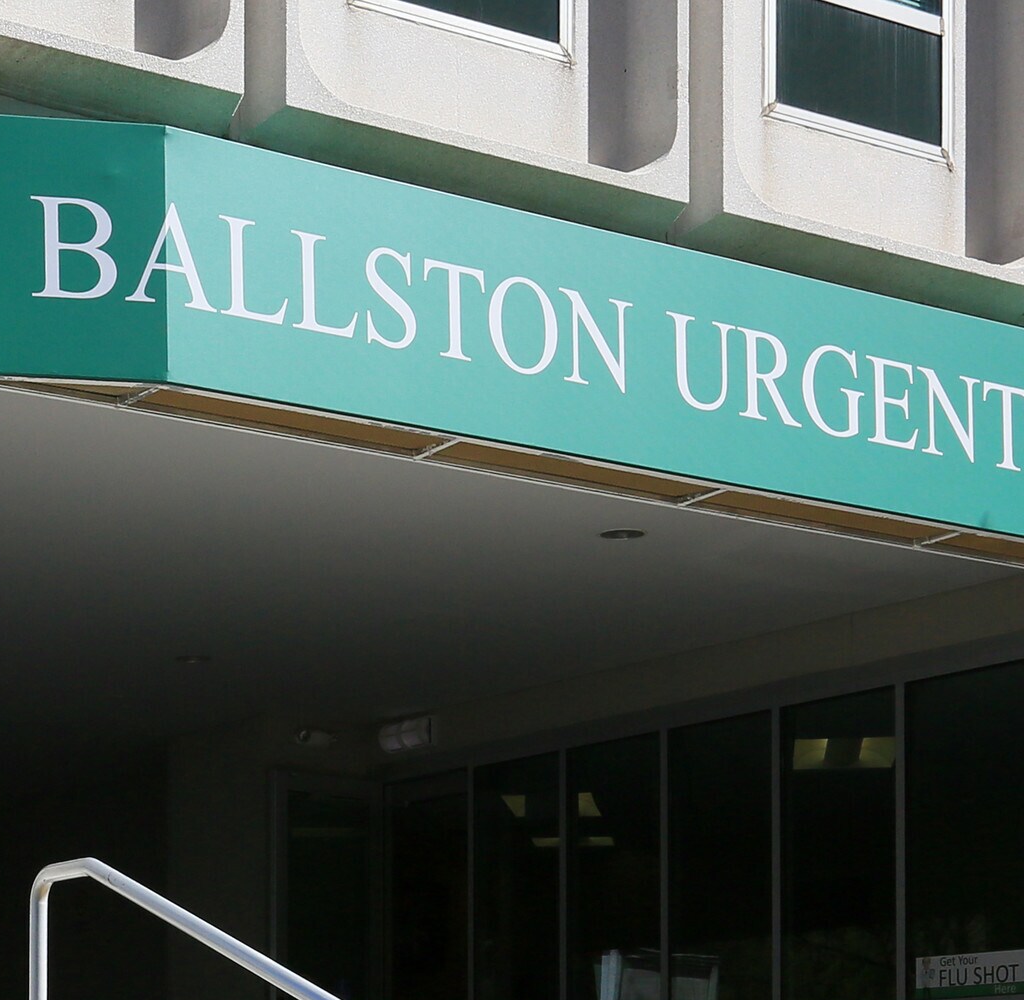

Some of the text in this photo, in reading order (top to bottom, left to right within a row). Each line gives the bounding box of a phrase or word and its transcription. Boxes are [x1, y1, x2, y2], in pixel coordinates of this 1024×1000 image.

[30, 195, 1024, 471] BALLSTON URGENT
[940, 955, 979, 967] Get Your
[939, 964, 1019, 987] FLU SHOT
[994, 983, 1017, 995] Here
